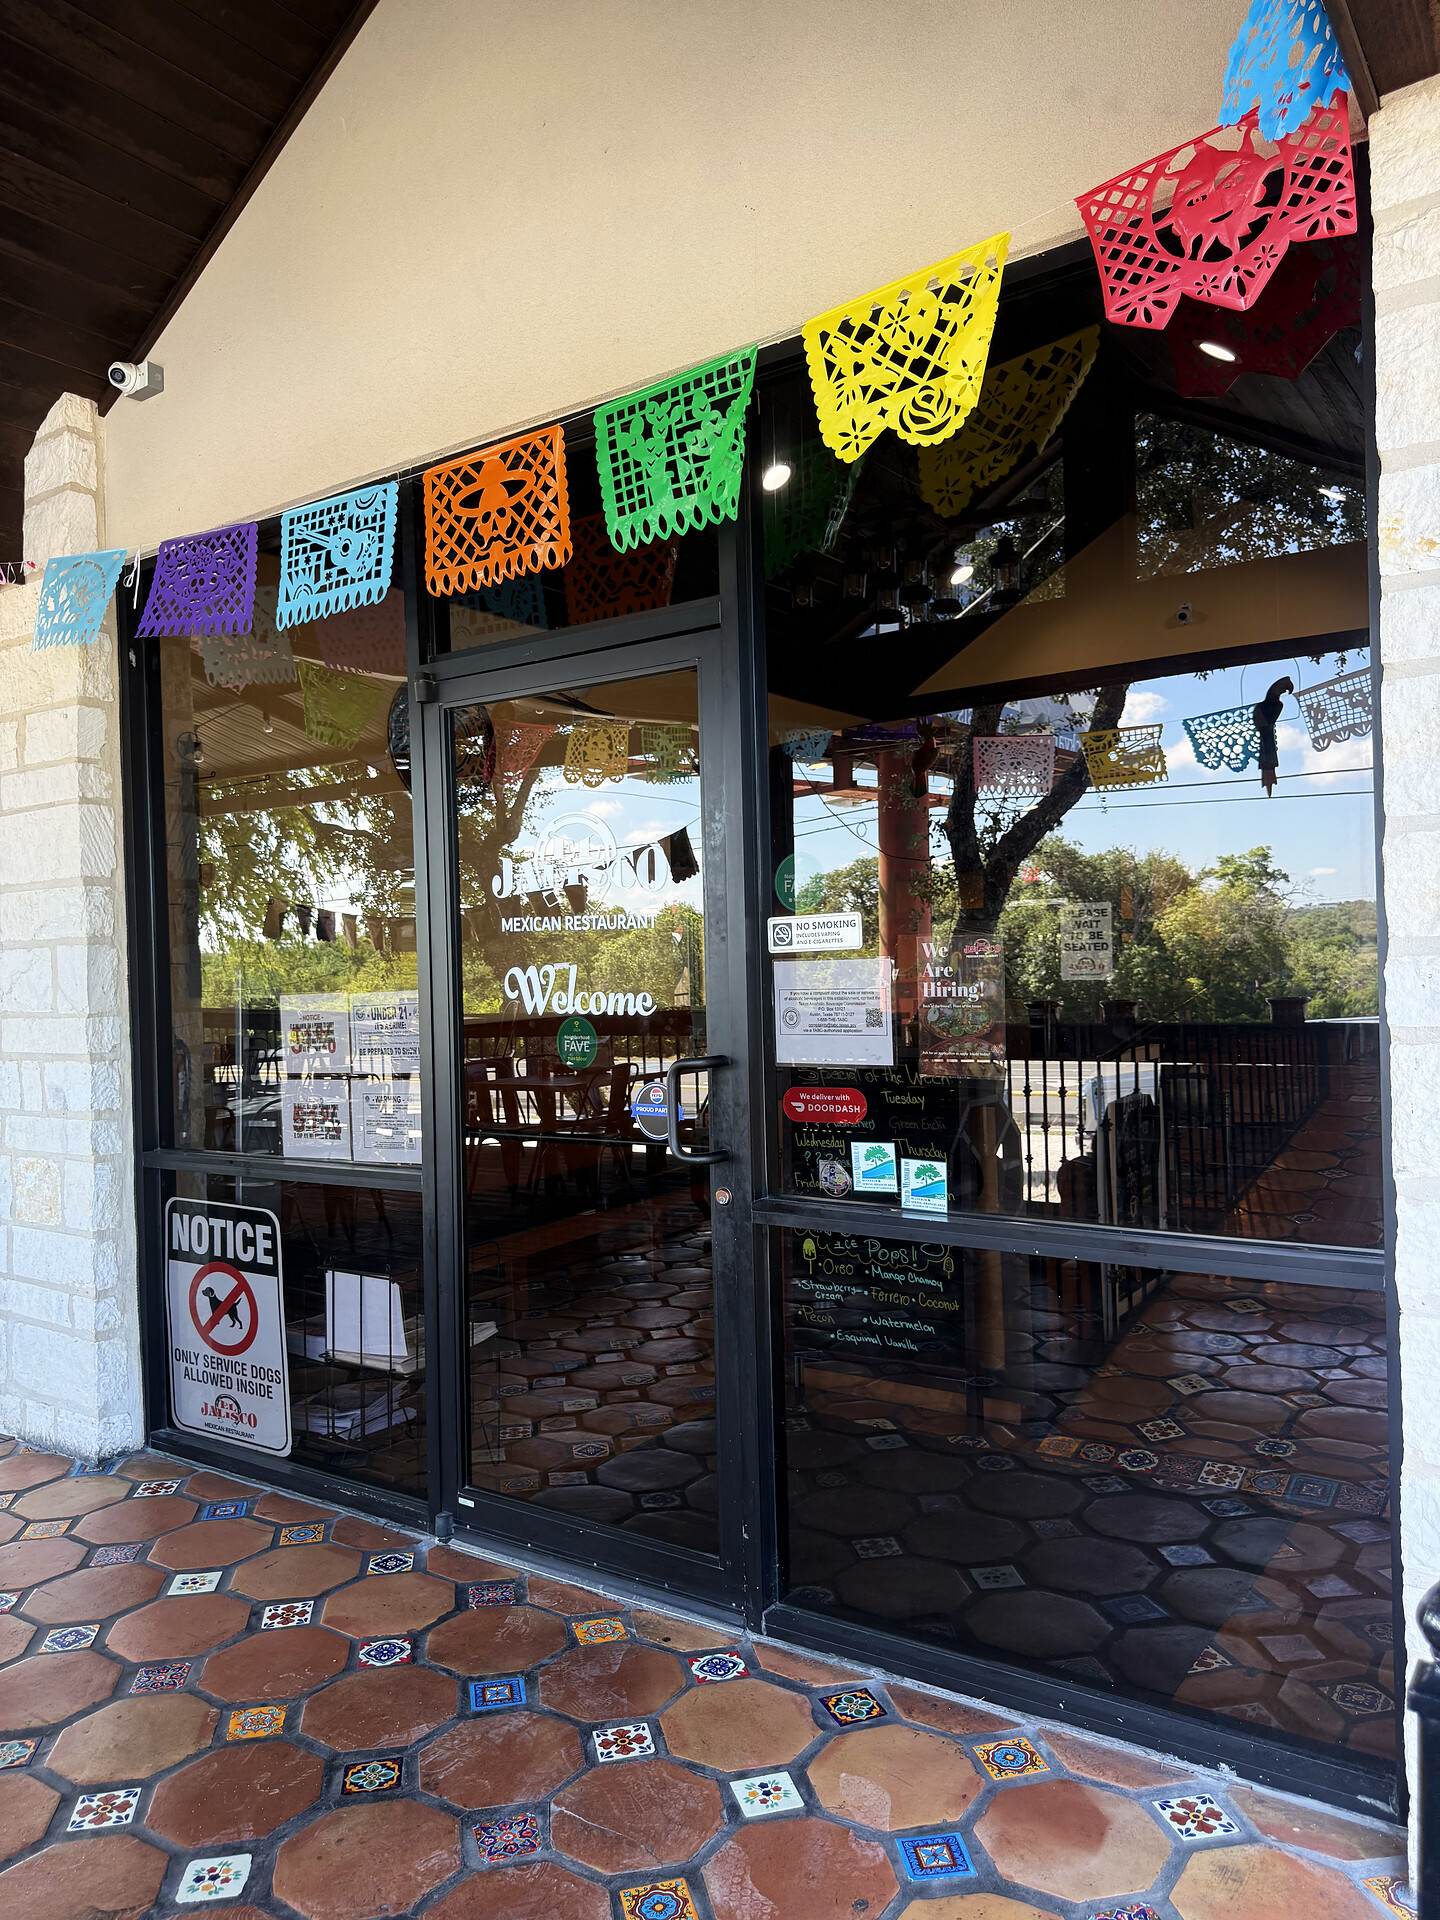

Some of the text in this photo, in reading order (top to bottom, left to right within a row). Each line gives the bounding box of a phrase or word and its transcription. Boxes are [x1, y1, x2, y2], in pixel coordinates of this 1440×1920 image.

[491, 845, 669, 899] JALISCO
[1067, 908, 1109, 918] LEASE
[501, 914, 655, 932] MEXICAN RESTAURANT
[796, 919, 857, 931] NO SMOKING
[1072, 919, 1101, 929] WAIT
[1067, 931, 1104, 940] TO BE
[922, 942, 949, 958] We
[1064, 942, 1109, 952] SEATED
[922, 962, 954, 977] Are
[504, 963, 657, 1016] Welcome
[922, 981, 984, 1002] Hiring!
[371, 1005, 407, 1020] UNDER 21
[360, 1048, 367, 1056] BE
[394, 1047, 402, 1055] TO
[564, 1040, 590, 1052] FAVE
[865, 1070, 880, 1084] of
[885, 1066, 904, 1084] the
[808, 1103, 861, 1113] DOORDASH
[880, 1089, 925, 1110] Tuesday
[794, 1133, 846, 1156] Wednesday
[891, 1138, 947, 1161] Thursday
[794, 1171, 822, 1188] Frida
[172, 1213, 274, 1265] NOTICE
[833, 1239, 859, 1250] ICE
[822, 1258, 944, 1292] Oreo Mango Chamoy
[800, 1279, 960, 1311] Strawberry Ferrero Coconut
[869, 1315, 935, 1335] Watermelon
[885, 1337, 919, 1352] Vanilla
[174, 1347, 282, 1385] ONLY SERVICE DOGS
[183, 1366, 274, 1400] ALLOWED INSIDE
[201, 1401, 258, 1428] JALISCO
[220, 1400, 237, 1412] EL
[204, 1422, 255, 1439] MEXICAN RESTAURANT
